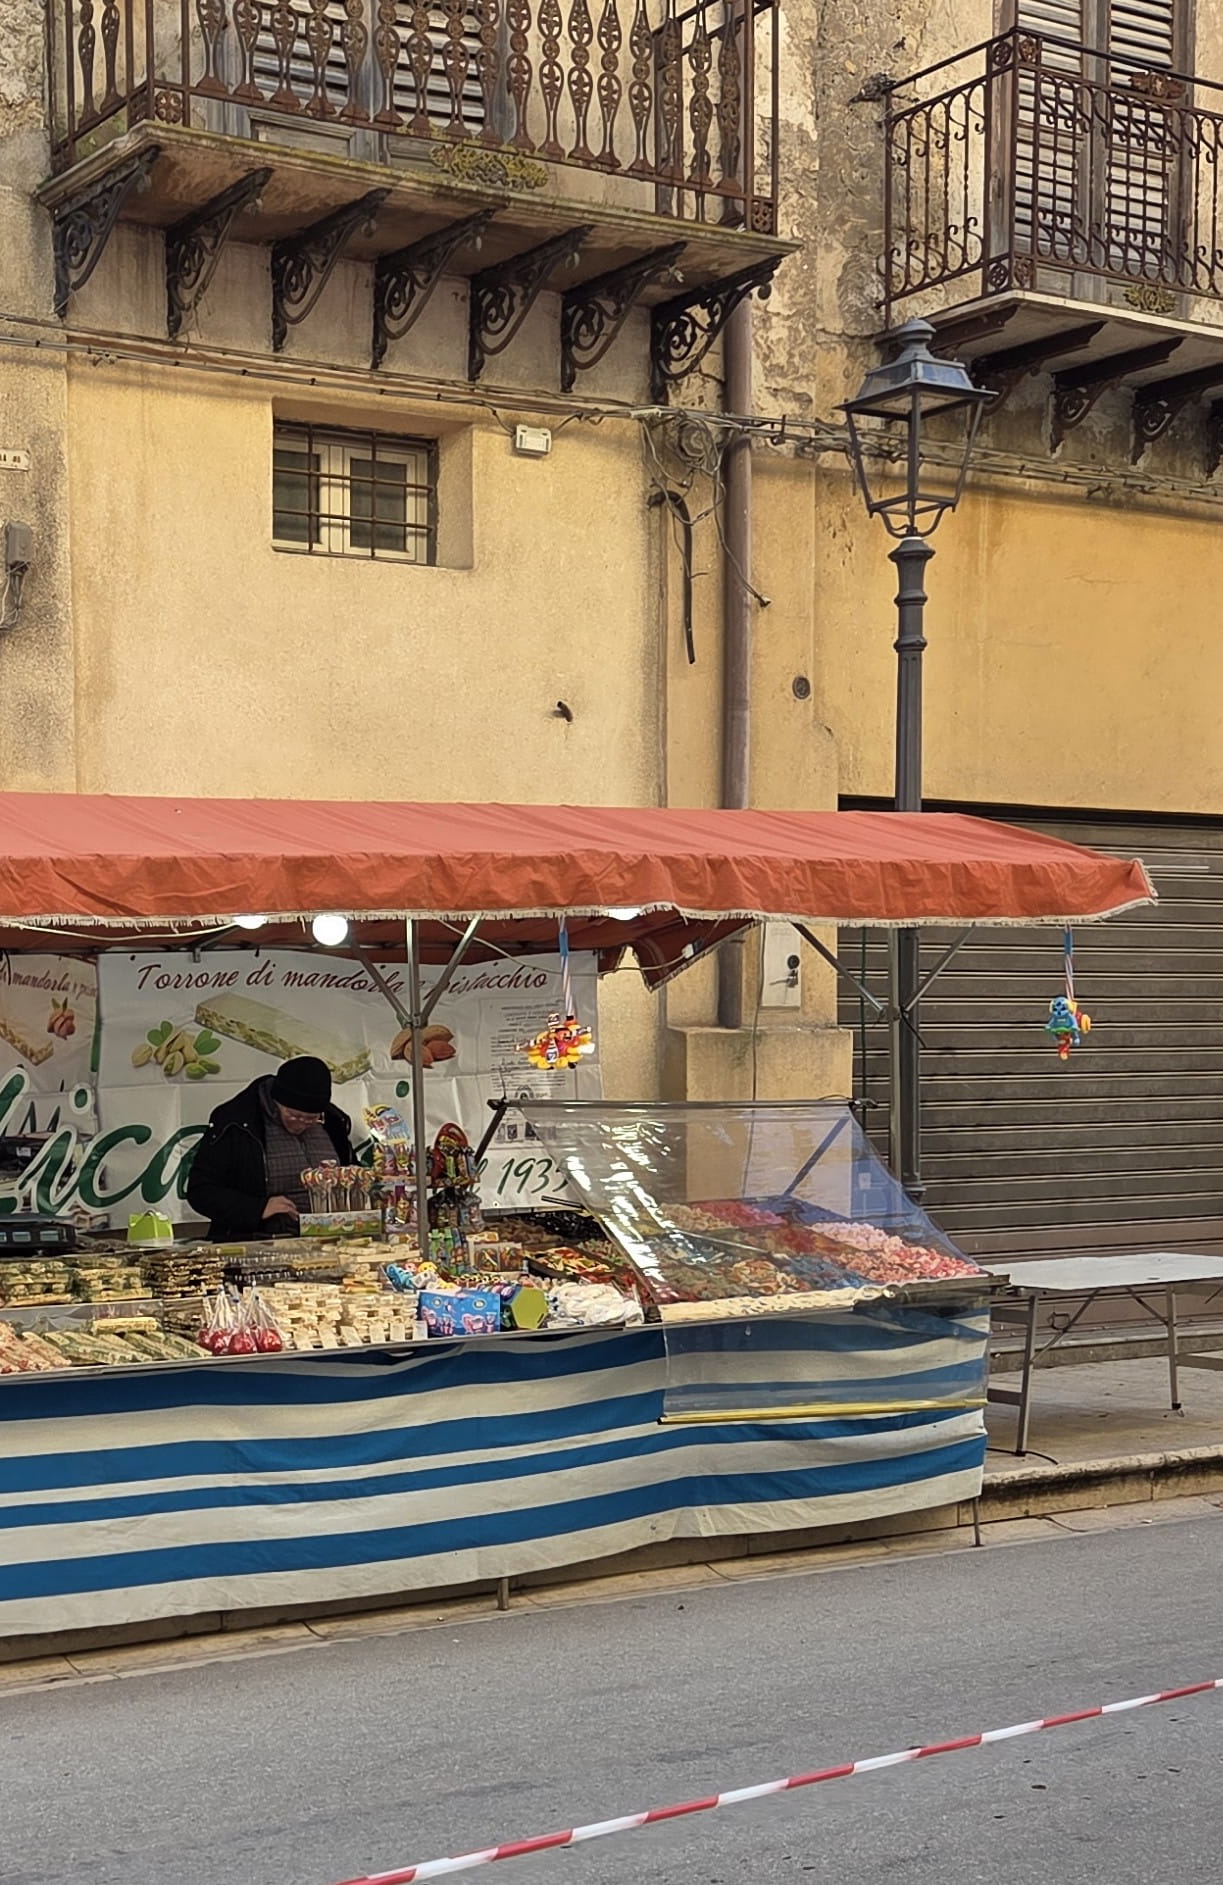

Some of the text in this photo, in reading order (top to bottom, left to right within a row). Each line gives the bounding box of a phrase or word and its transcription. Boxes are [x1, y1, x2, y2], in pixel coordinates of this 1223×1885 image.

[13, 970, 70, 992] mandorla
[137, 964, 240, 989] Torrone
[246, 959, 276, 986] di
